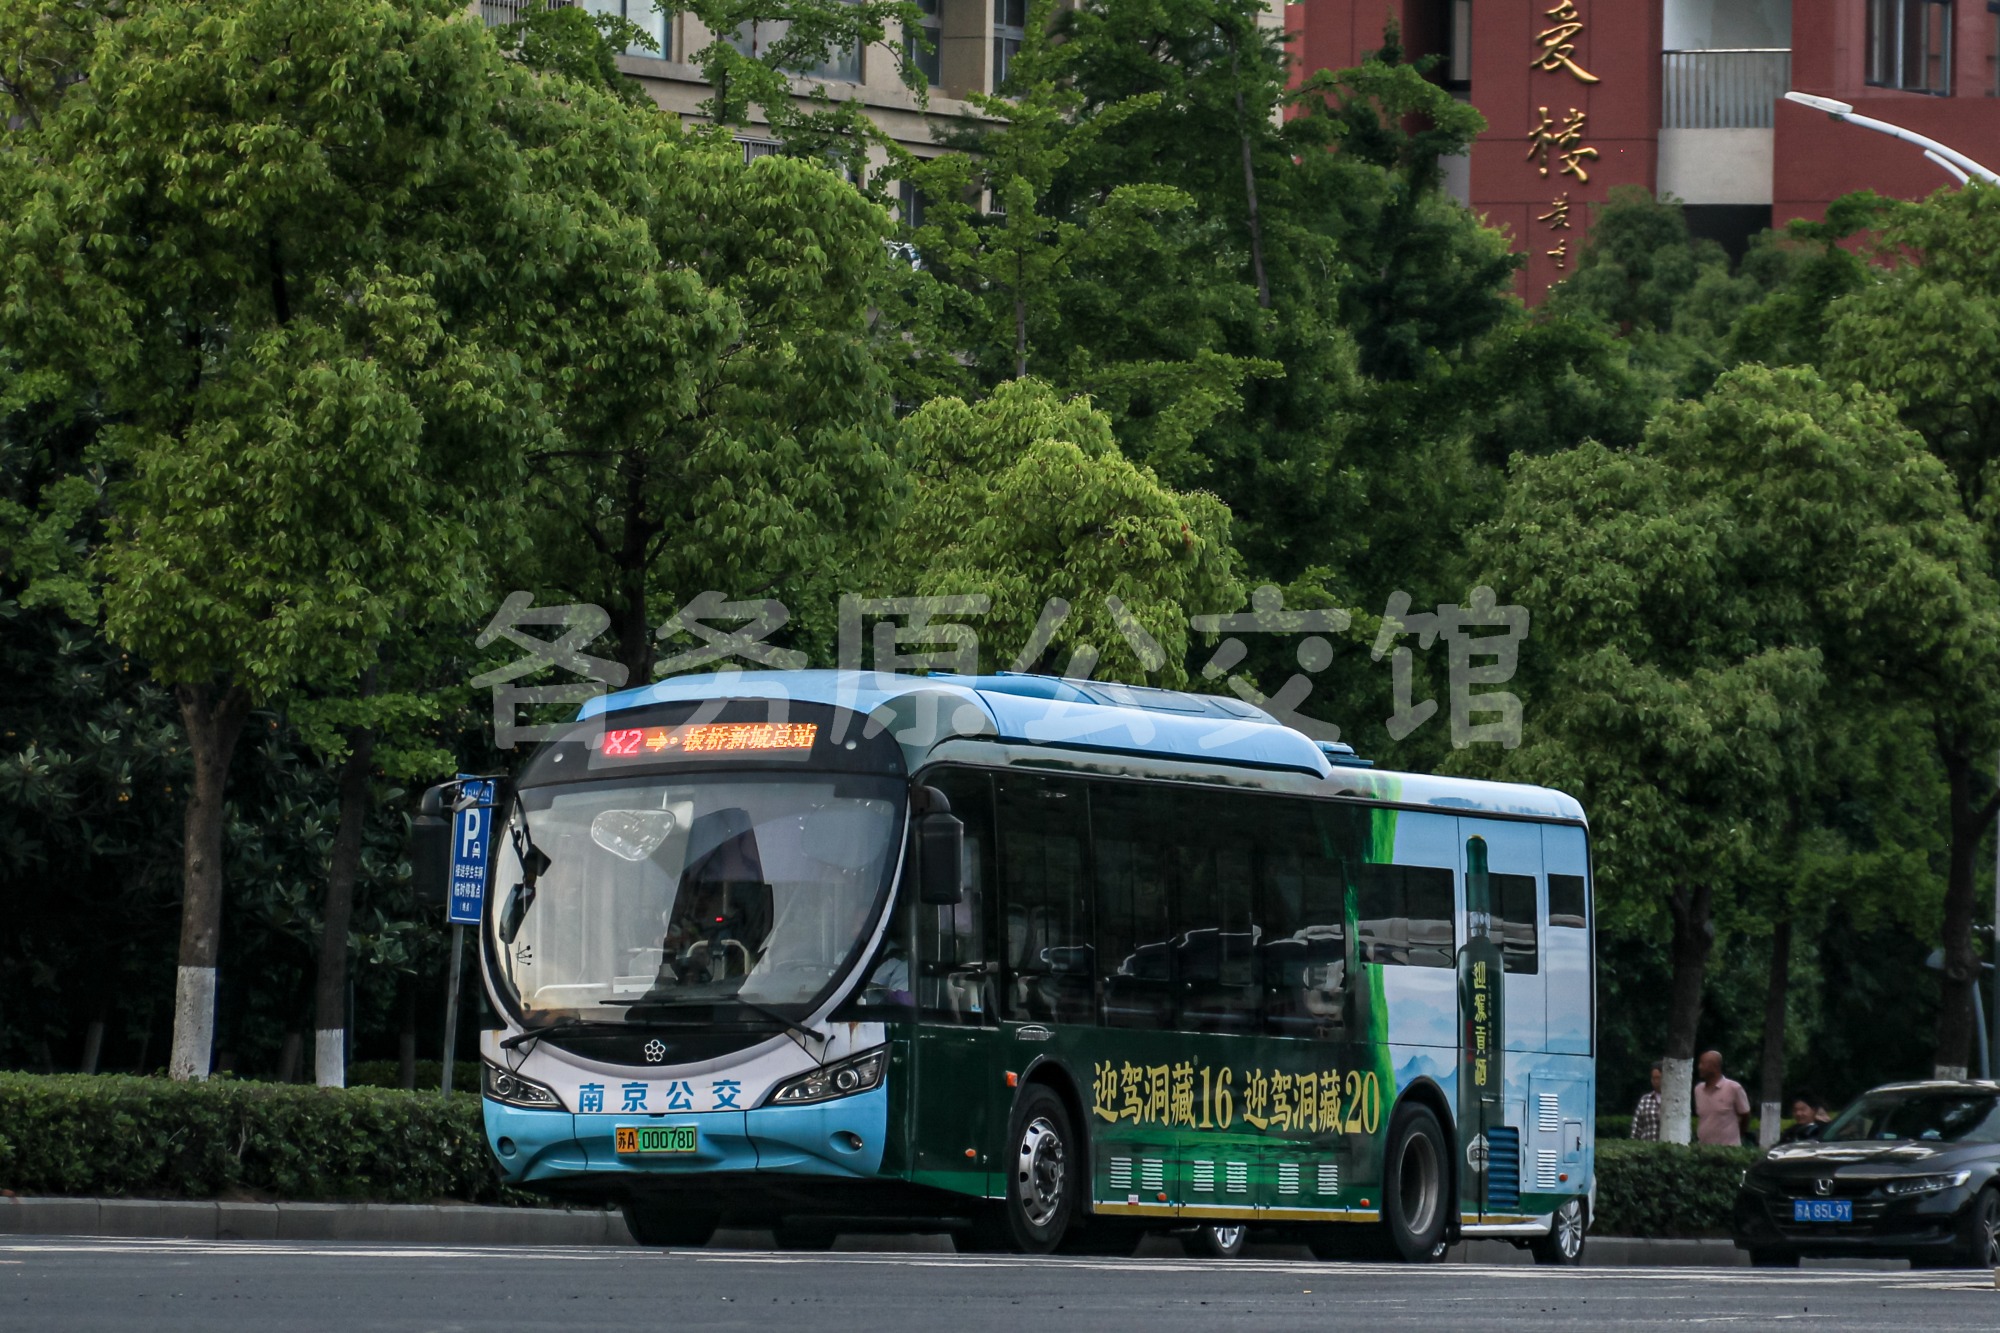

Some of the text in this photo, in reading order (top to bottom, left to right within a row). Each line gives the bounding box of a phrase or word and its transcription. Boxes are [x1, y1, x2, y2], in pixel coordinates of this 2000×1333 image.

[605, 723, 818, 755] X2 板桥新城总站
[462, 808, 480, 858] P
[454, 882, 481, 899] 临时停靠点
[578, 1079, 742, 1113] 南京公交
[1092, 1059, 1380, 1136] 迎驾洞藏16 迎驾洞藏20
